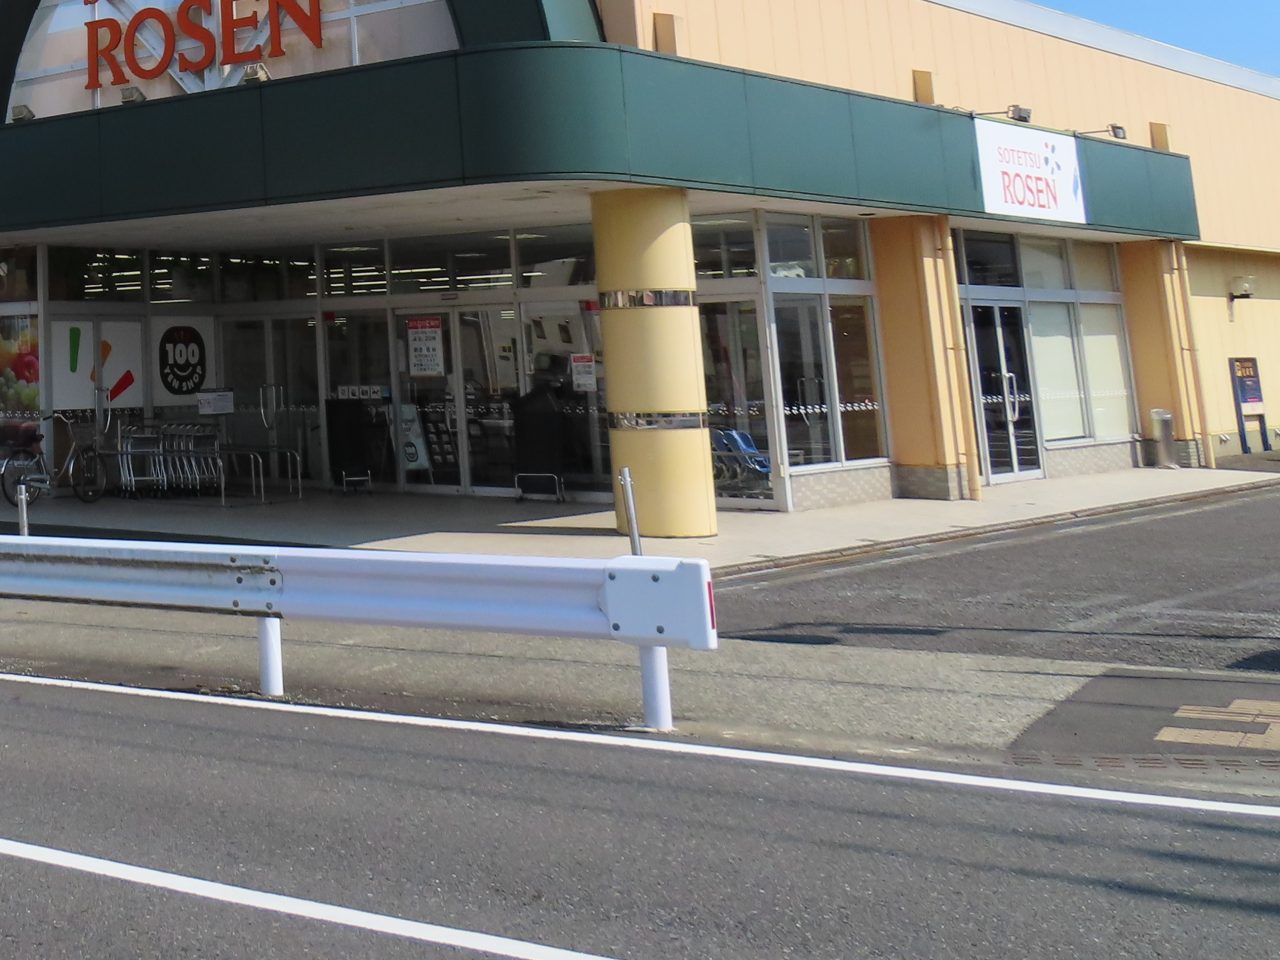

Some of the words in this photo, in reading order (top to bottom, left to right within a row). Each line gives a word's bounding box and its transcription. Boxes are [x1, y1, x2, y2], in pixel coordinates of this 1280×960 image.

[997, 146, 1041, 169] SOTETSU
[1000, 170, 1059, 209] ROSEN
[165, 342, 200, 365] 100
